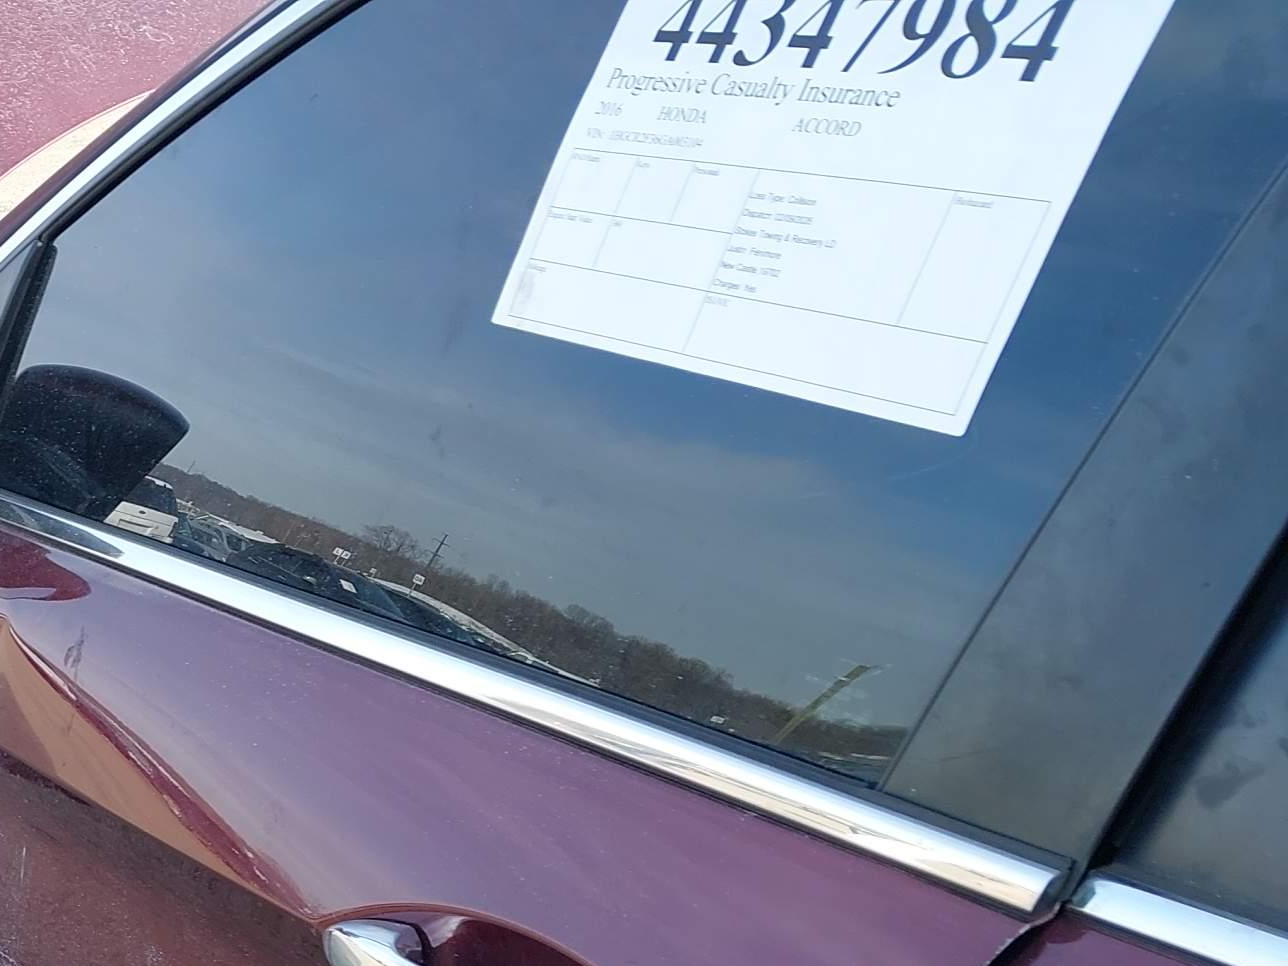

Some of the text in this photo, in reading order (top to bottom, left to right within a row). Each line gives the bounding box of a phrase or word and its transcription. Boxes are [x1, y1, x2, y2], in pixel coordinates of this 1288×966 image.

[653, 0, 1074, 82] 44347984
[606, 67, 902, 108] Progressive Casualty Insurance
[656, 105, 708, 123] HONDA
[792, 117, 862, 137] ACCORD
